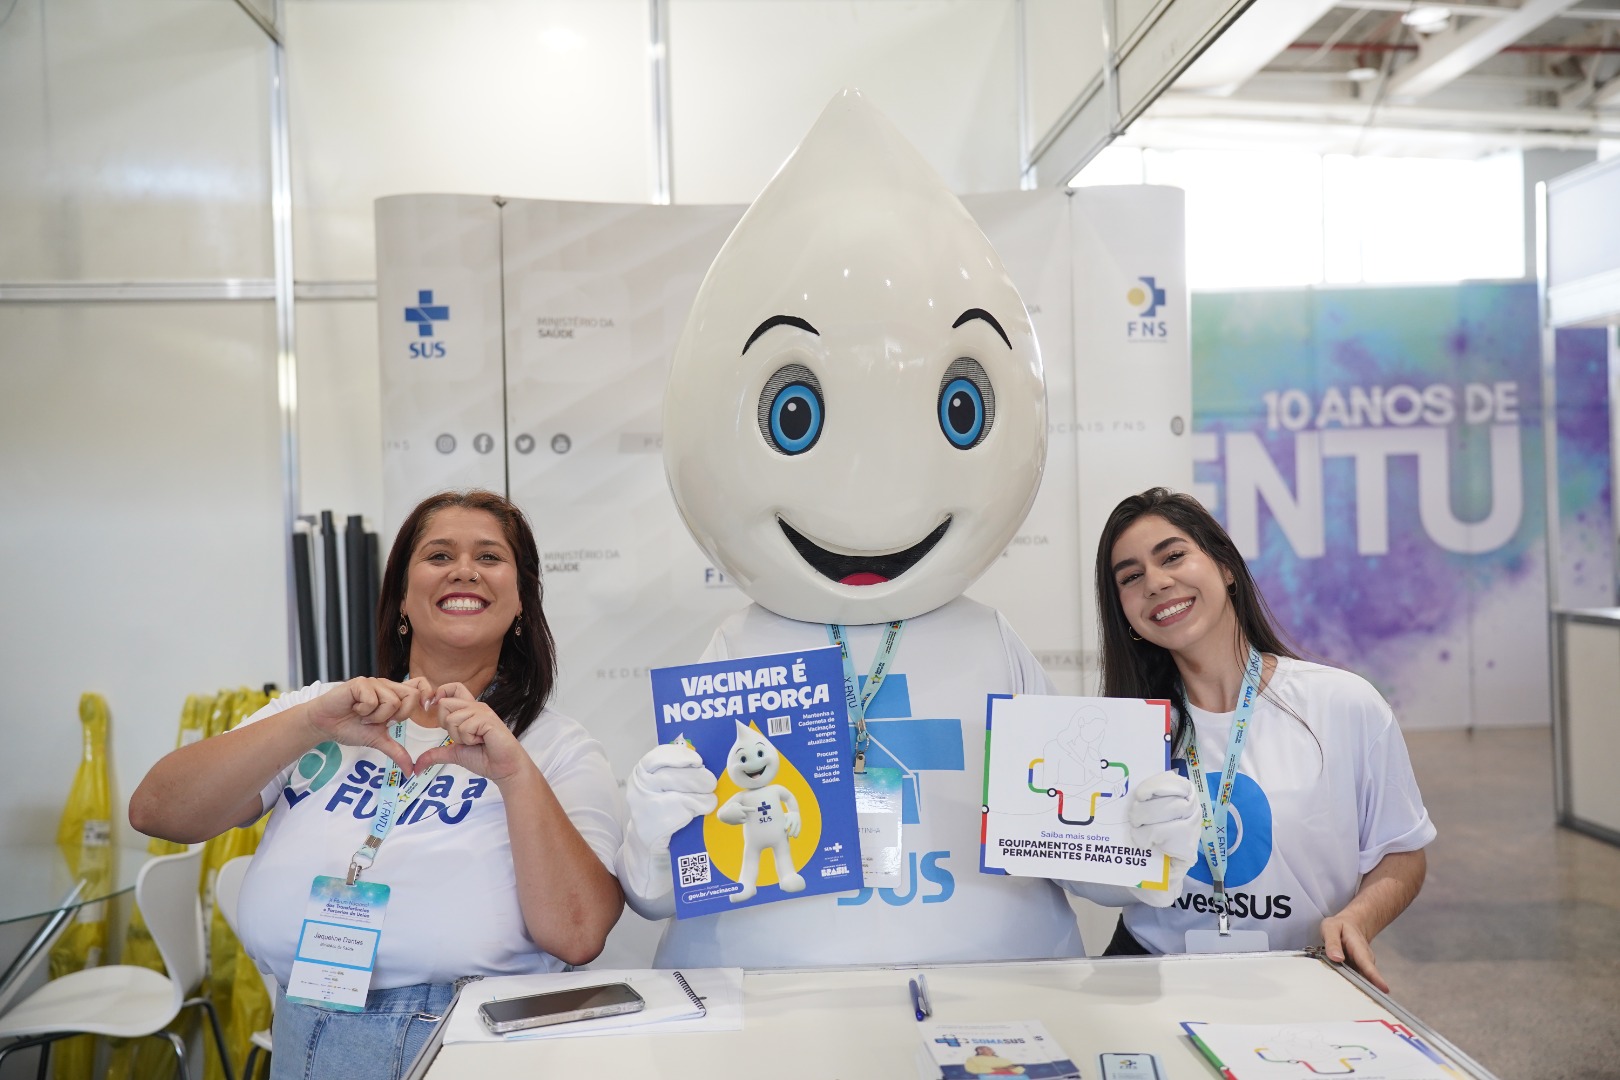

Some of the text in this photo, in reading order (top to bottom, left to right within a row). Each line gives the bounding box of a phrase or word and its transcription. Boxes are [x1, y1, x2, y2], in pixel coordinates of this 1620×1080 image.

[600, 317, 614, 328] DA
[538, 328, 574, 339] SAÚDE
[1127, 321, 1167, 337] FNS
[409, 342, 446, 358] SUS
[1263, 381, 1519, 430] 10 ANOS DE
[1048, 420, 1105, 434] OCIAIS
[605, 549, 620, 559] DA
[681, 658, 807, 697] VACINAR É
[1242, 685, 1253, 708] CAIXA
[663, 683, 830, 724] NOSSA FORÇA
[802, 711, 830, 720] Mantenha
[798, 718, 827, 727] Caderneta
[807, 723, 836, 732] Vacinação
[815, 730, 837, 738] sempre
[807, 737, 837, 746] atualizada.
[816, 750, 839, 758] Procure
[816, 763, 839, 771] Unidade
[813, 771, 832, 779] Básica
[461, 777, 488, 799] a
[375, 799, 393, 833] X FNTU
[759, 815, 773, 824] SUS
[1040, 830, 1110, 842] Saiba mais sobre
[1216, 826, 1225, 834] X
[998, 838, 1152, 858] EQUIPAMENTOS E MATERIAIS
[1207, 841, 1218, 867] CAIXA
[1002, 847, 1147, 867] PERMANENTES PARA O SUS
[821, 865, 850, 877] BRASIL
[688, 886, 739, 901] gov.br/vacinacao
[1171, 892, 1292, 920] vestSUS
